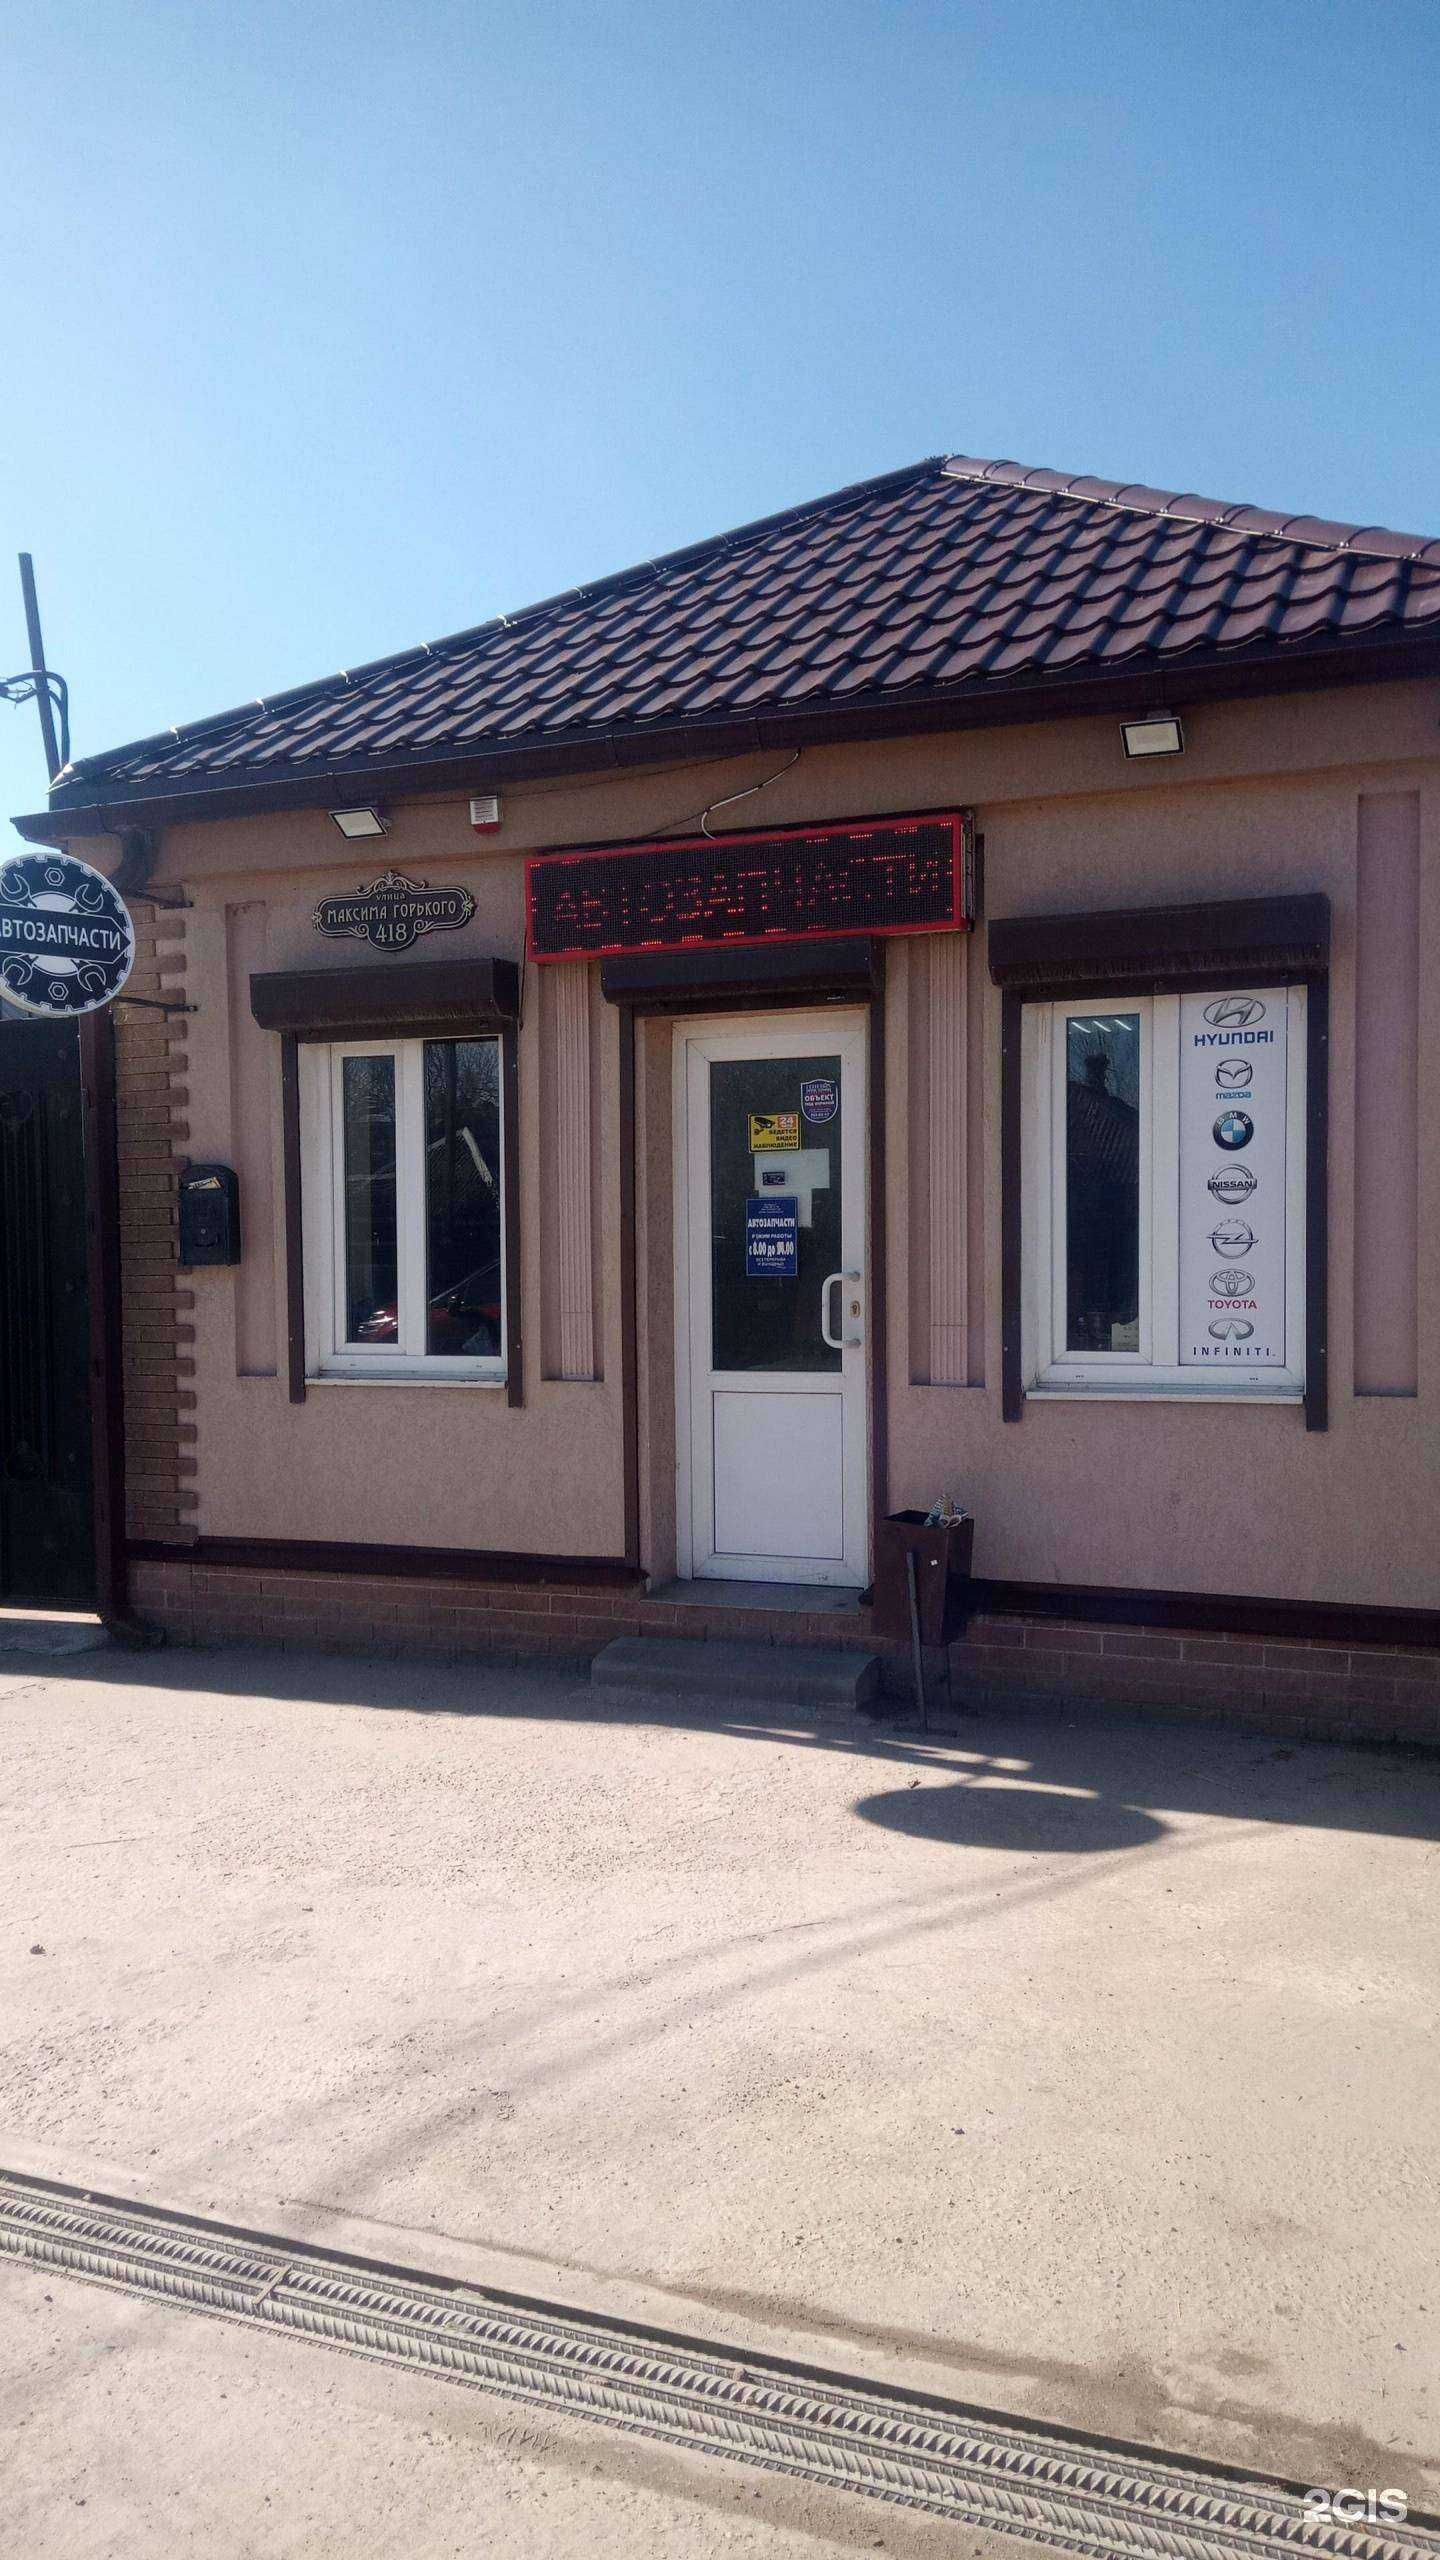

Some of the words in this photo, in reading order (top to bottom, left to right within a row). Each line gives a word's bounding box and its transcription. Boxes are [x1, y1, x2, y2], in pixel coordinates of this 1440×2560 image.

[327, 905, 387, 923] МАКСИМА
[393, 901, 456, 919] ГОРЬКОГО
[0, 918, 121, 950] ВТОЗАПЧАСТИ
[375, 923, 407, 942] 418
[1194, 1030, 1274, 1047] HYUNDAI
[804, 1093, 834, 1102] ОБЪЕКТ
[747, 1218, 795, 1228] АВТОЗАПЧАСТИ
[1208, 1300, 1258, 1310] TOYOTA
[1193, 1347, 1270, 1356] INFINITI
